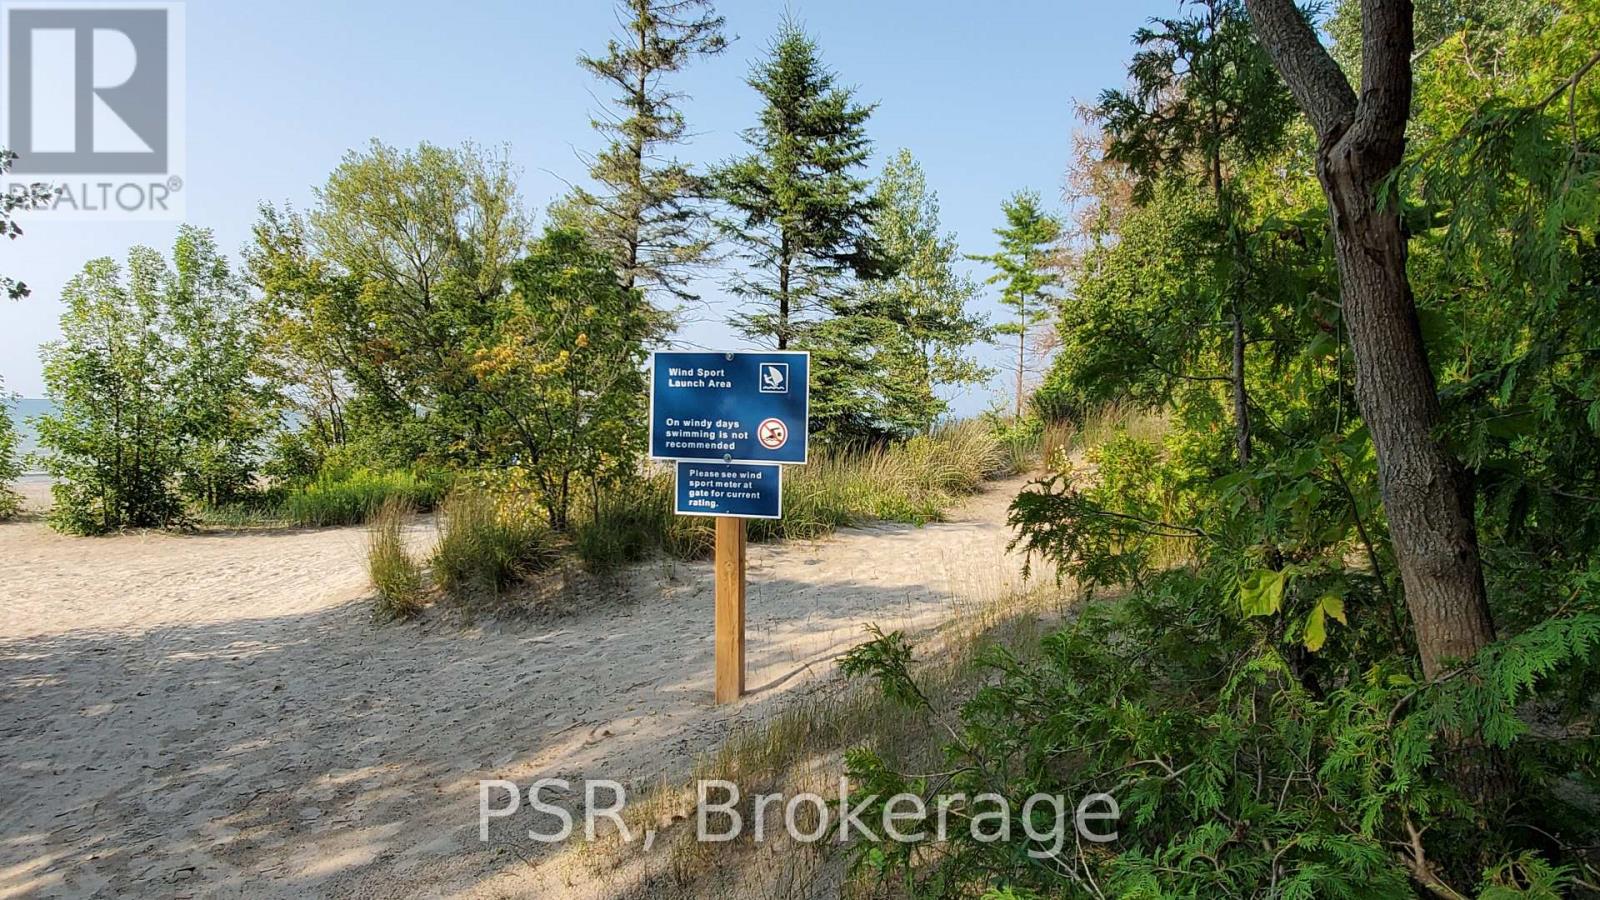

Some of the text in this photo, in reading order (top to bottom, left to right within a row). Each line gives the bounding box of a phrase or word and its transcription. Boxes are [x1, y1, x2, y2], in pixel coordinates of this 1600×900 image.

[668, 368, 725, 379] Wind Sport
[668, 379, 732, 388] Launch Area
[666, 418, 740, 430] On windy days
[666, 429, 749, 440] swimming is not
[665, 441, 736, 450] recommended
[689, 469, 762, 480] Please see wind
[689, 480, 714, 489] sport
[715, 480, 742, 489] meter
[689, 489, 760, 500] gate for current
[688, 499, 719, 509] rating.
